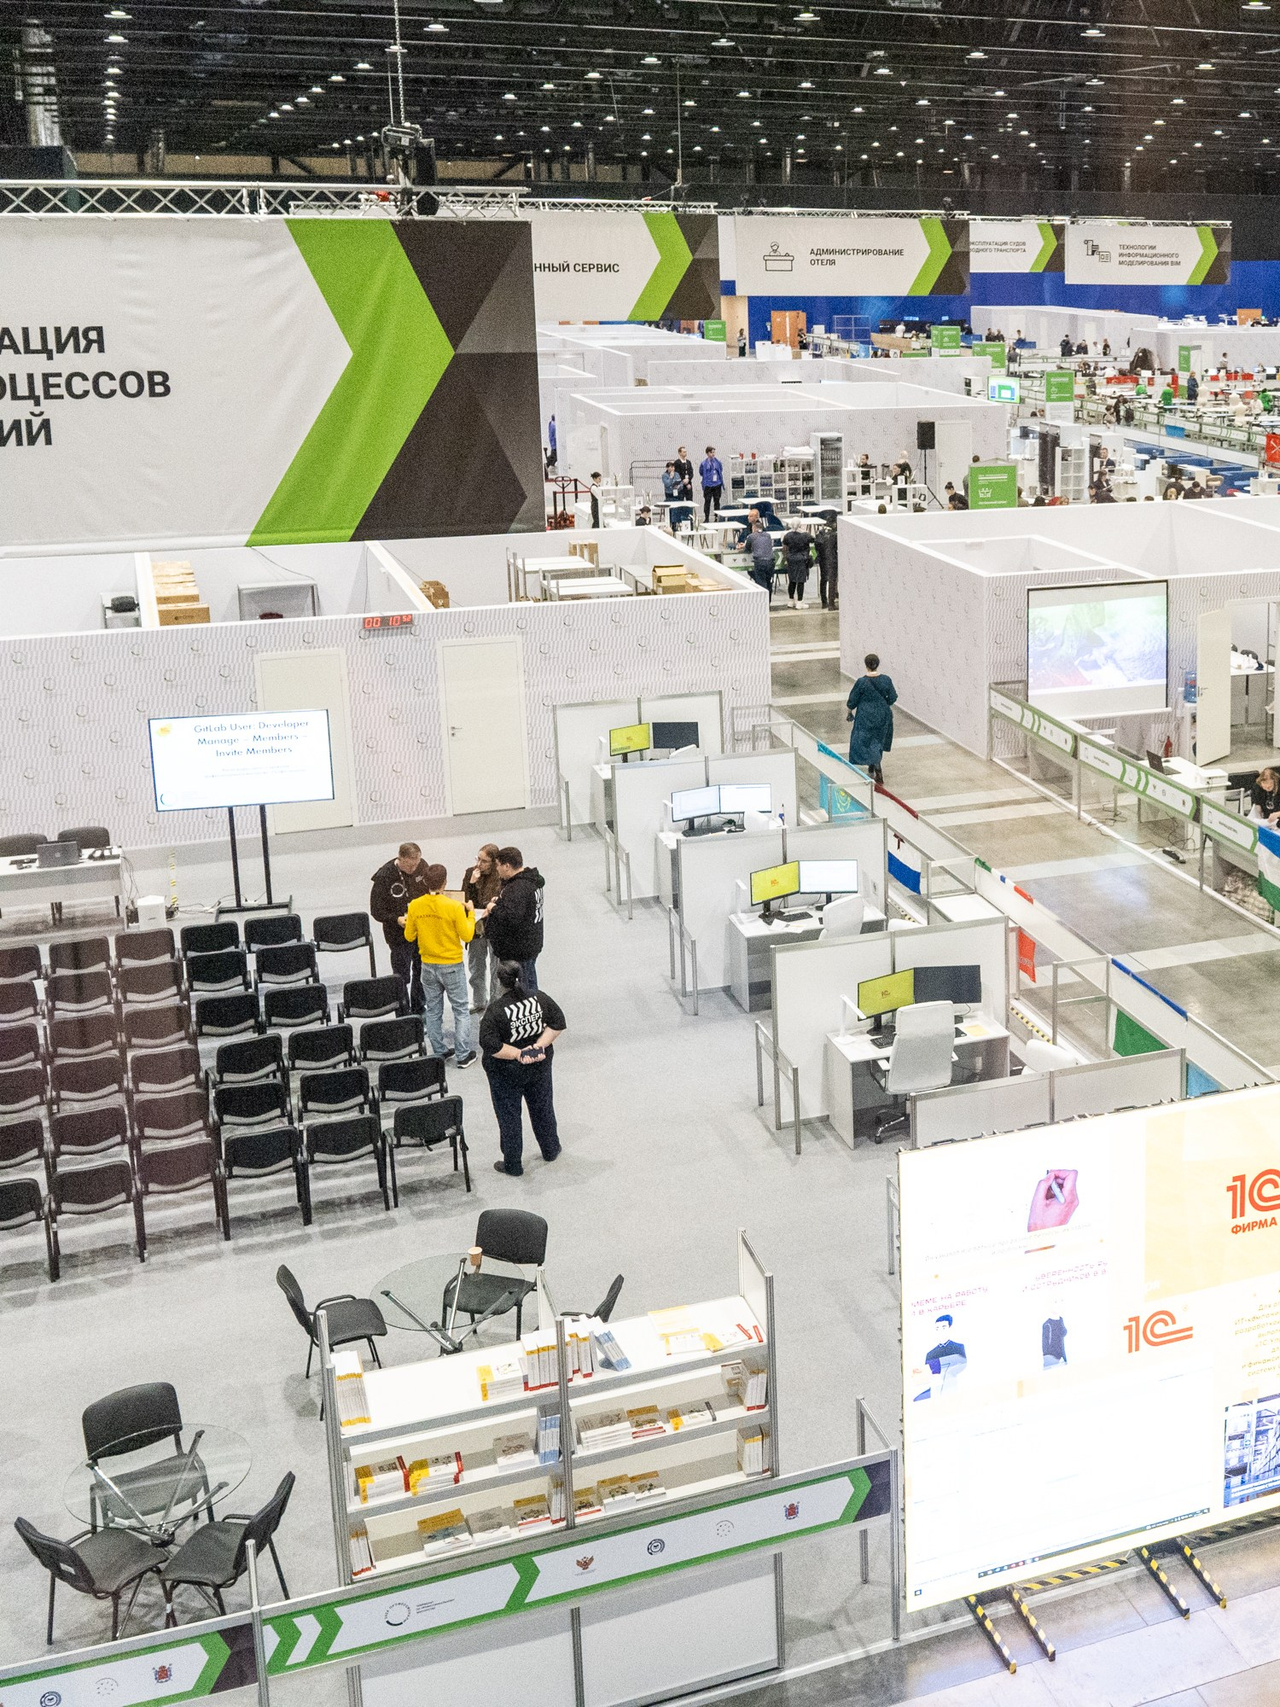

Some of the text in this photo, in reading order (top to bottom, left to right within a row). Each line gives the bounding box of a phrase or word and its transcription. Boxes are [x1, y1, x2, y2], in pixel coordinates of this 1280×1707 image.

[809, 248, 905, 256] АДМИНИСТРИРОВАНИЕ
[573, 263, 620, 273] СЕРВИС
[809, 258, 836, 266] ОТЕЛЯ
[0, 370, 172, 407] ЦЕССОВ
[194, 723, 227, 734] GitLab
[258, 720, 309, 731] Developer
[197, 734, 299, 747] Manage Members
[215, 746, 293, 758] Invite Members
[510, 1010, 543, 1029] ЭКСПЕРТ
[1231, 1217, 1278, 1234] ФИРМА
